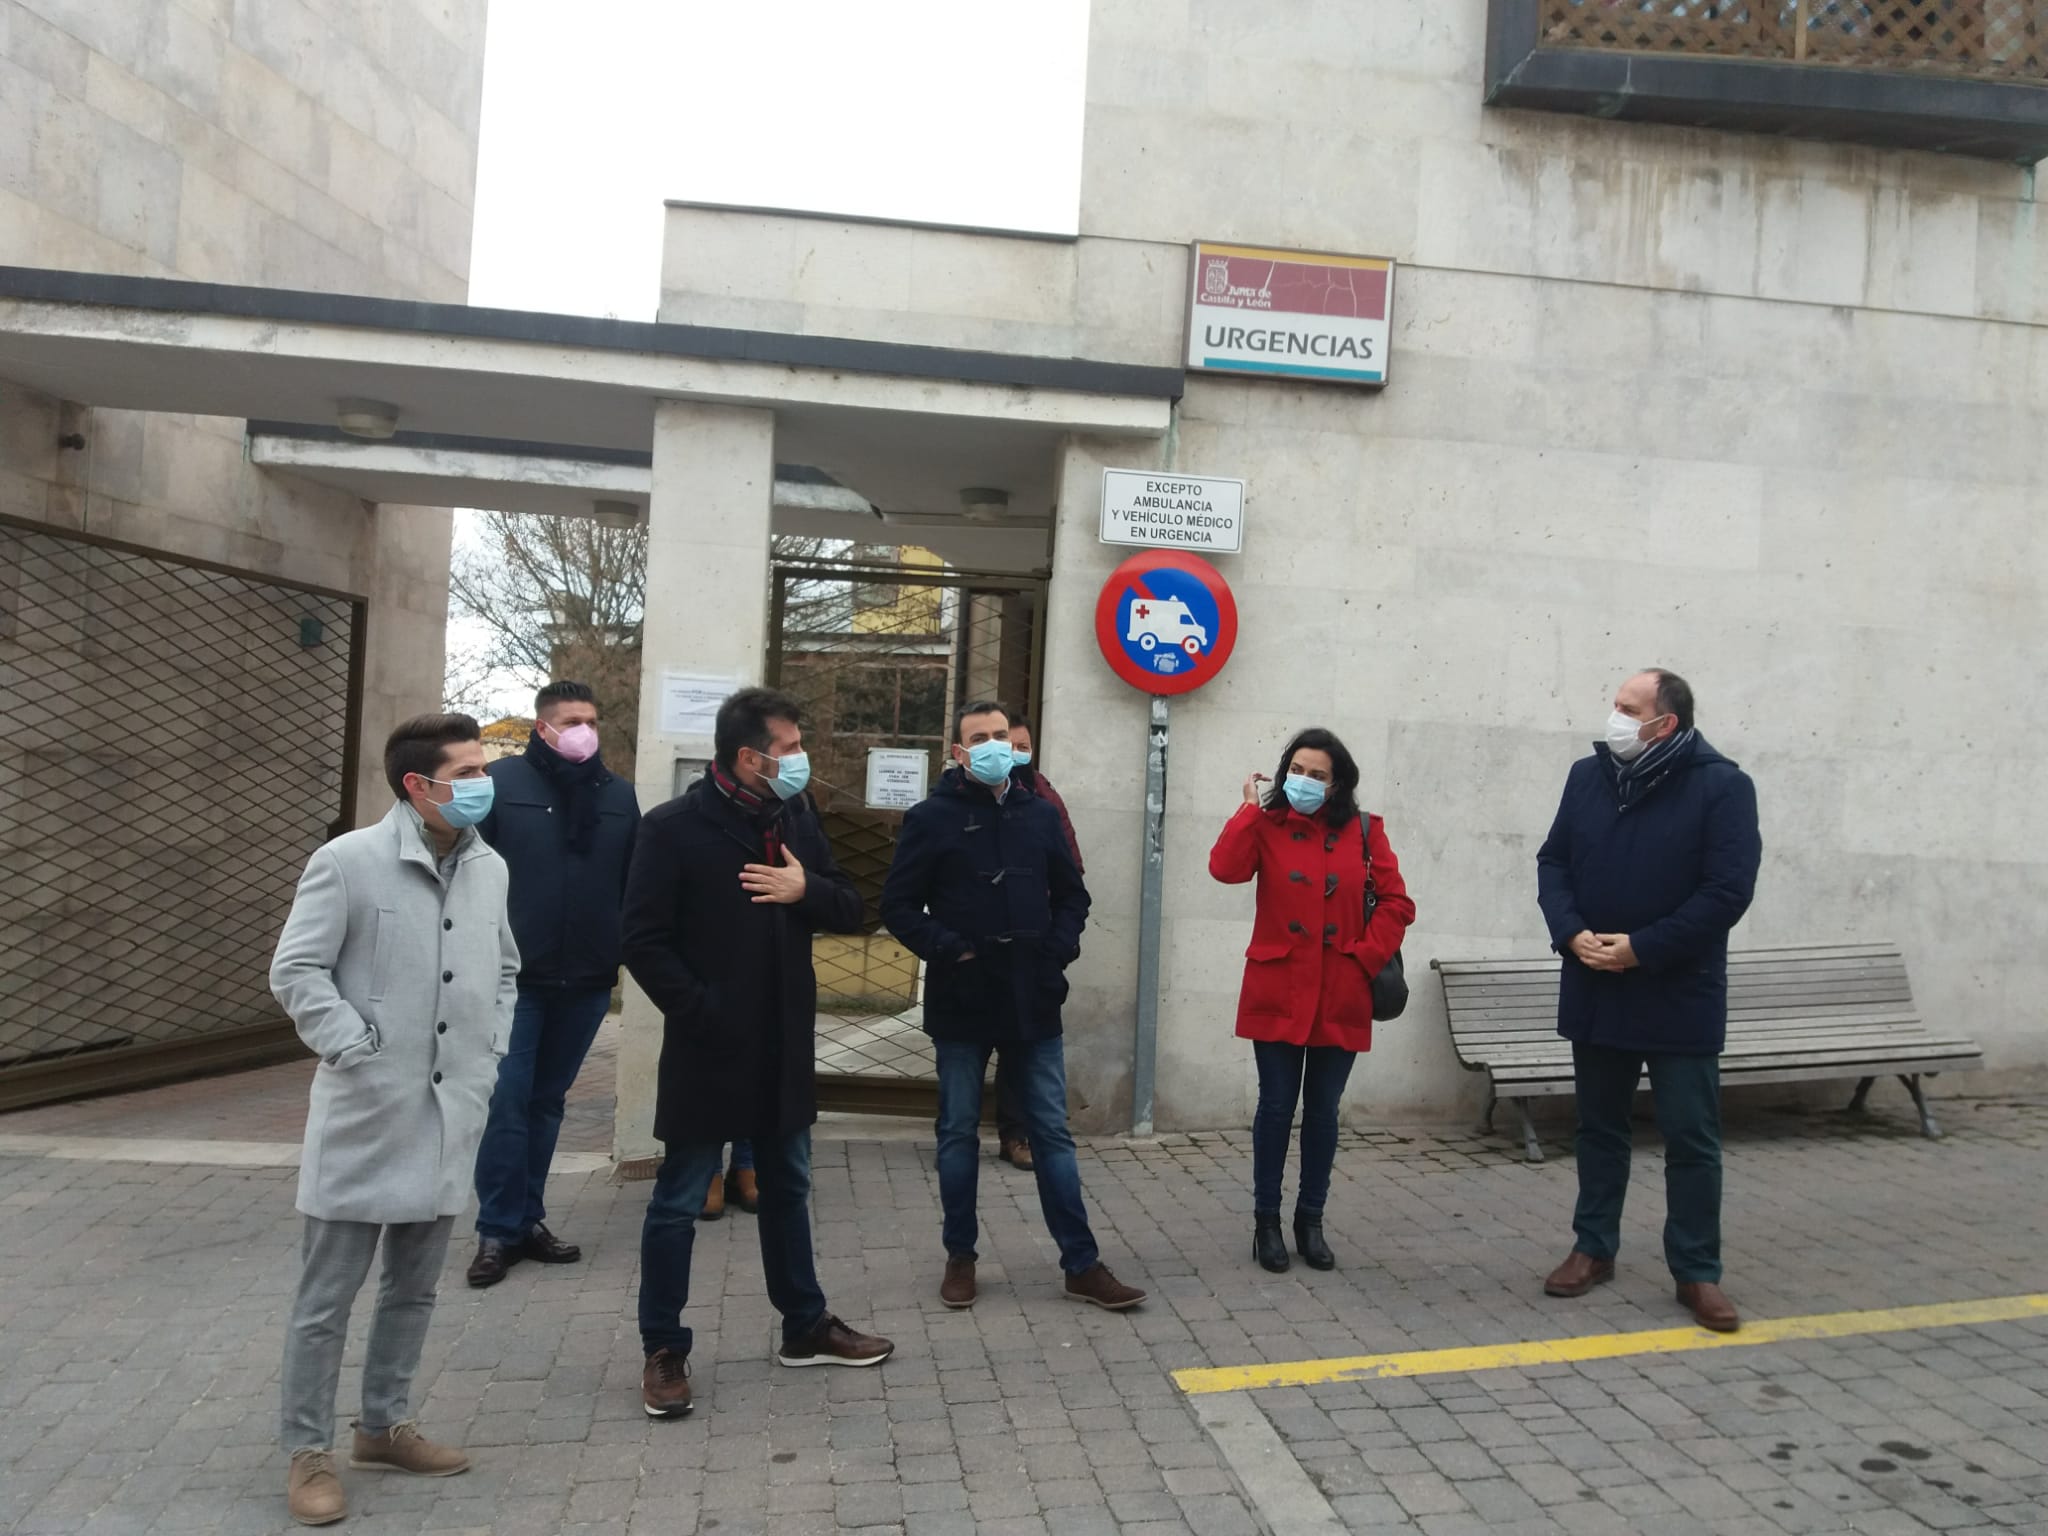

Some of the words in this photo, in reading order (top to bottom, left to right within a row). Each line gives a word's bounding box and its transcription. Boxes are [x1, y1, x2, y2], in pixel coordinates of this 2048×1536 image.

[1200, 292, 1235, 306] Castilla
[1237, 298, 1244, 309] y
[1246, 297, 1271, 309] León
[1257, 289, 1272, 299] de
[1205, 324, 1373, 360] URGENCIAS
[1146, 481, 1202, 496] EXCEPTO
[1133, 495, 1213, 513] AMBULANCIA
[1111, 509, 1119, 520] Y
[1122, 509, 1183, 526] VEHÍCULO
[1186, 513, 1233, 529] MÉDICO
[1130, 526, 1147, 538] EN
[1150, 527, 1212, 543] URGENCIA
